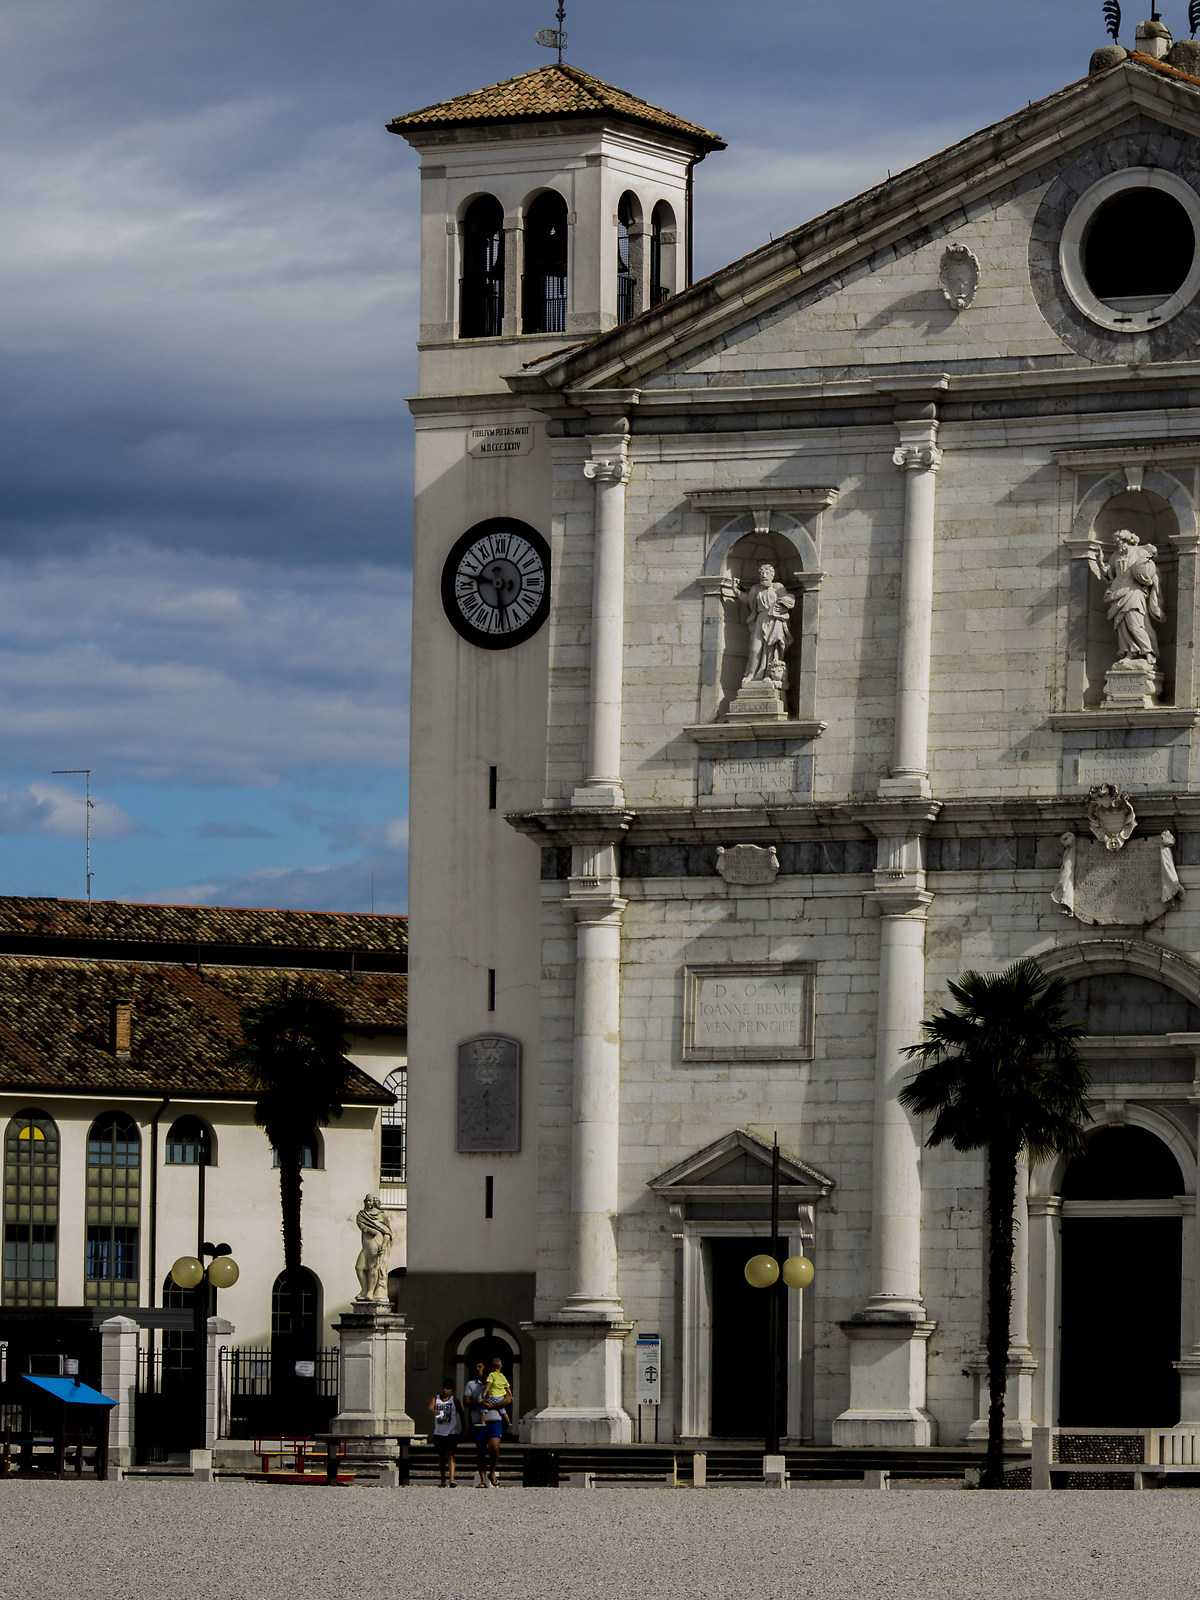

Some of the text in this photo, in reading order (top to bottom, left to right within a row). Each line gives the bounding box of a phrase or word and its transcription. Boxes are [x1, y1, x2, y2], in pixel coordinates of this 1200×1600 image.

[1095, 752, 1160, 764] CHRISTO
[722, 777, 791, 788] TVTELARI
[700, 1002, 802, 1016] IOANNE BEMBO
